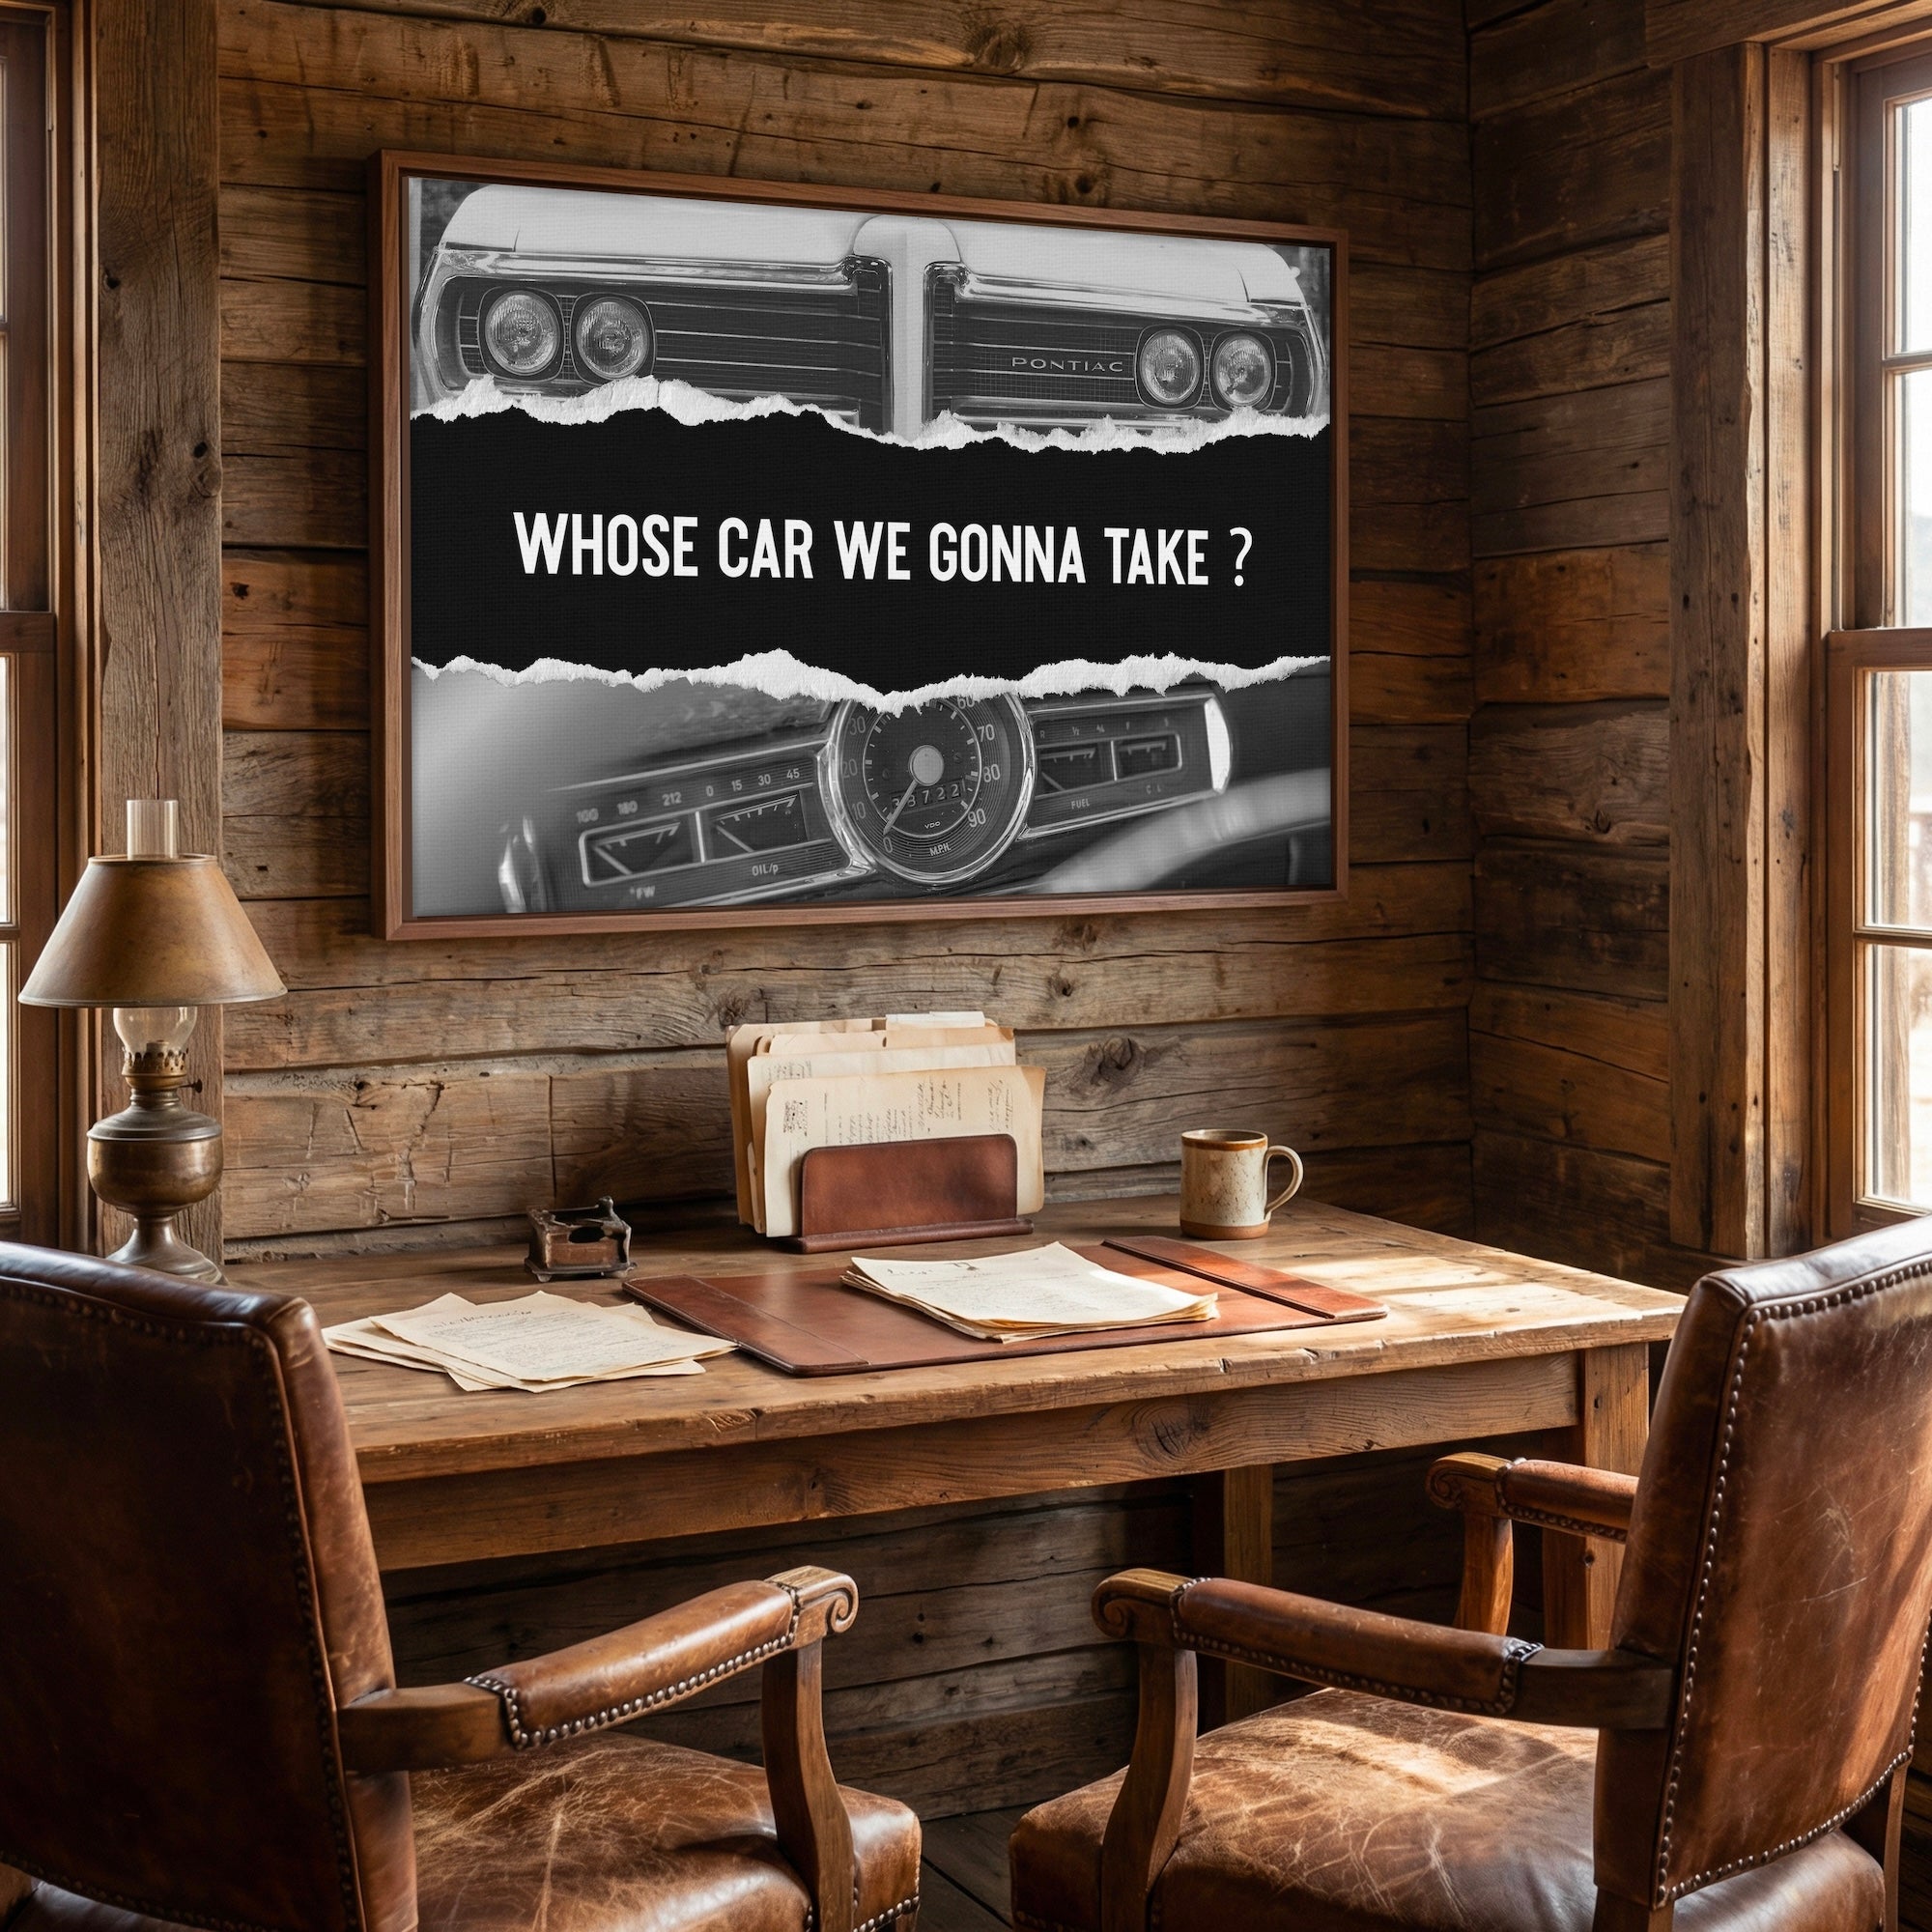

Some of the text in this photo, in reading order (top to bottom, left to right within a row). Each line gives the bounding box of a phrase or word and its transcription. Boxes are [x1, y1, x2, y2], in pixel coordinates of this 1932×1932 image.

[1011, 356, 1123, 372] PONTIAC
[513, 511, 1253, 587] WHOSE CAR WE GONNA TAKE ?
[977, 724, 995, 743] 70
[731, 779, 743, 792] 15
[757, 774, 772, 786] 30
[786, 768, 800, 780] 45
[981, 763, 1001, 783] 80
[661, 791, 682, 807] 212
[1070, 798, 1091, 810] FUEL
[851, 801, 867, 820] 10
[967, 808, 986, 828] 90
[923, 820, 941, 829] VDO
